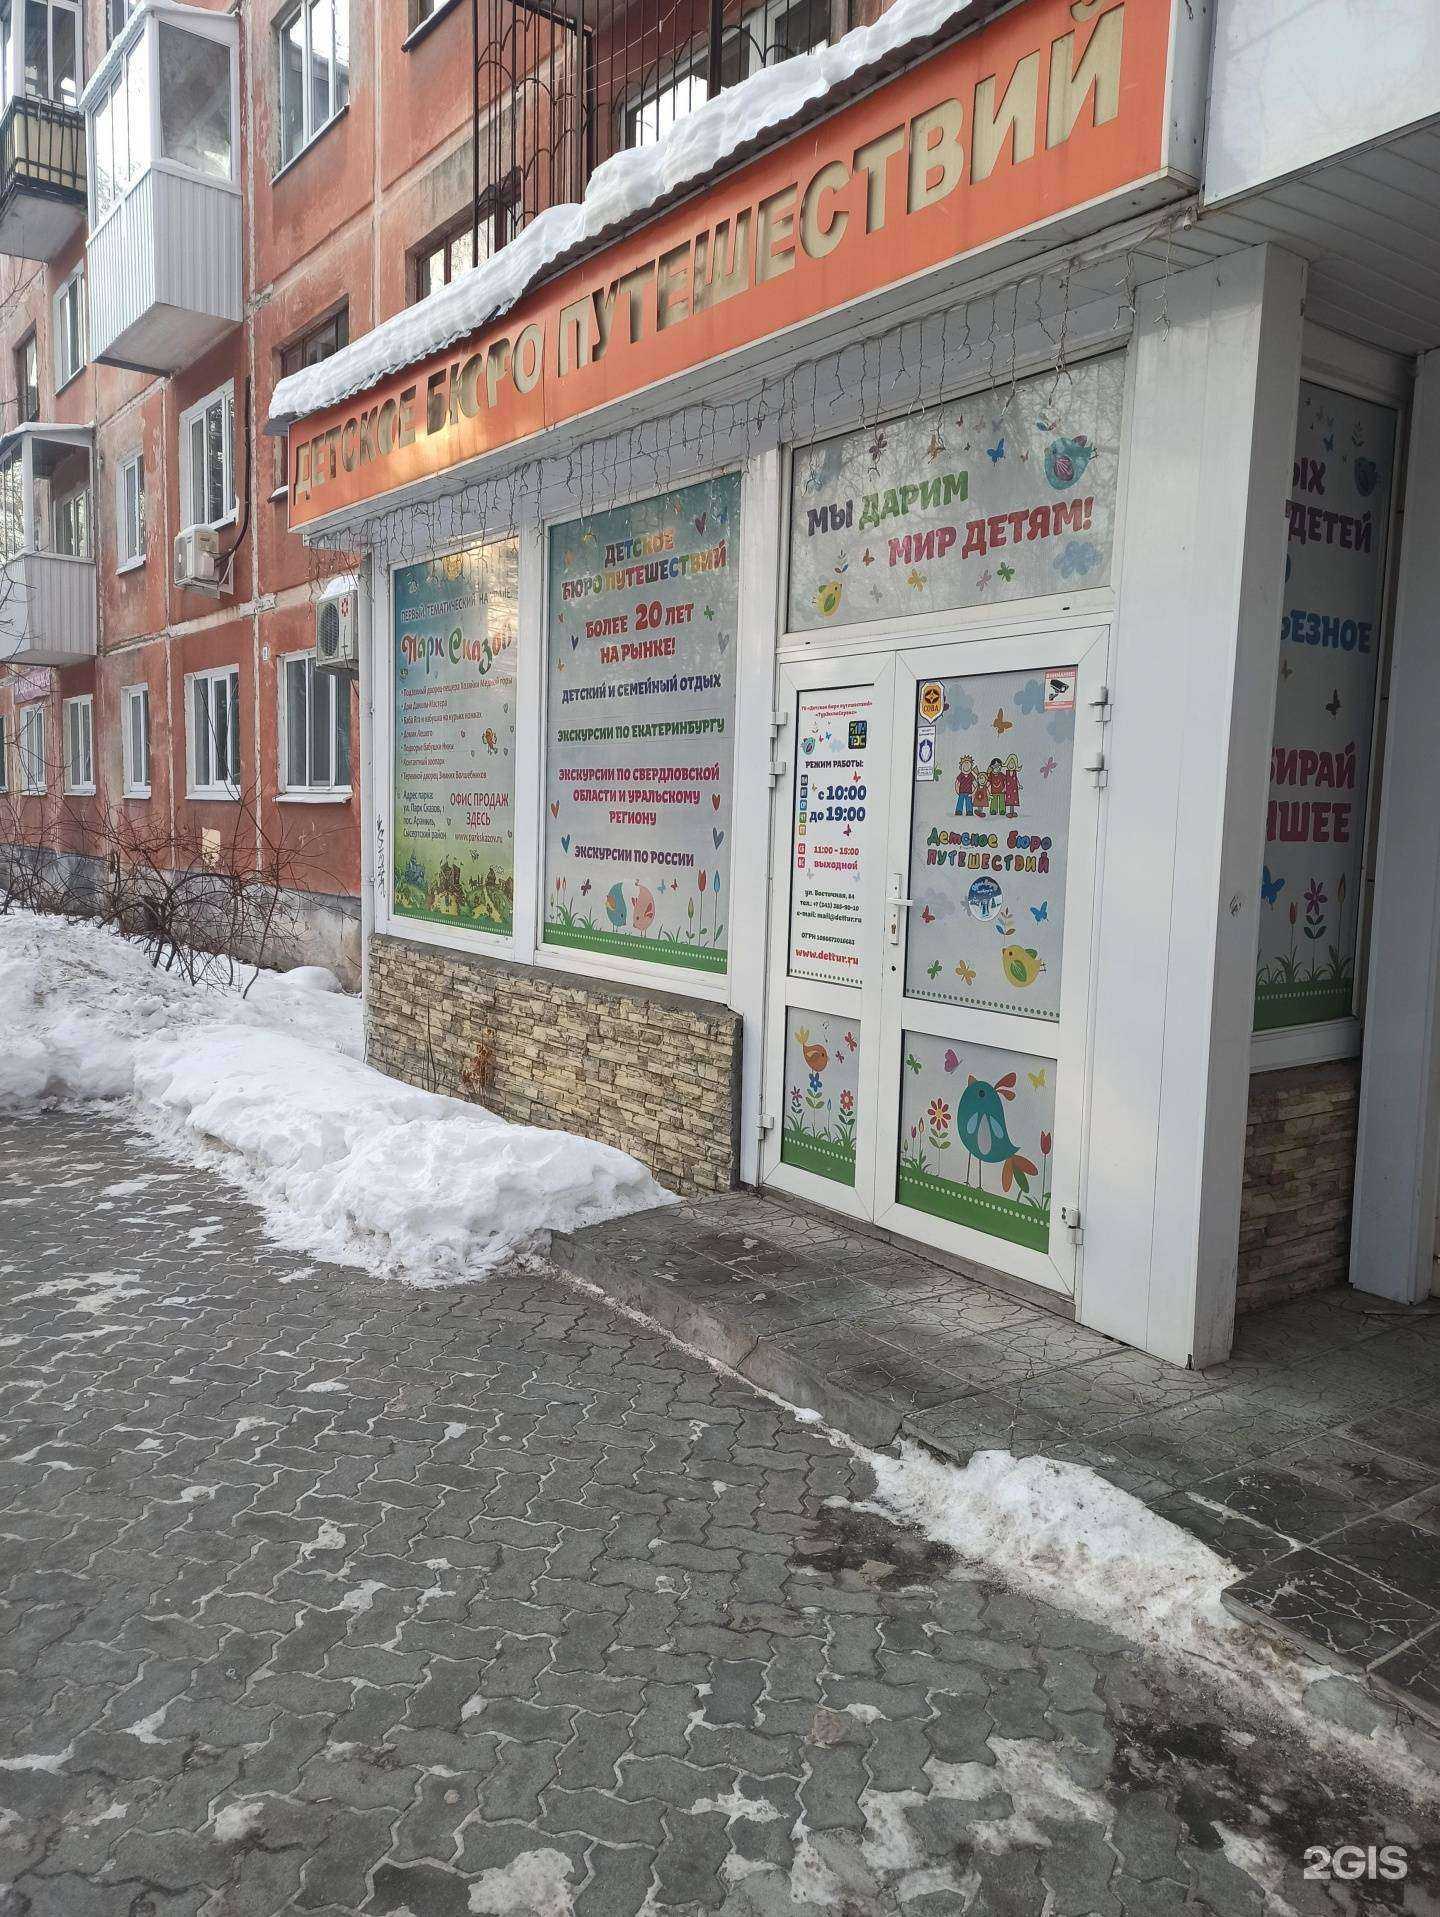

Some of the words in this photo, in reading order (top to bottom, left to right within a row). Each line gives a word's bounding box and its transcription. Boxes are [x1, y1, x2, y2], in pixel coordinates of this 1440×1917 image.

[294, 384, 417, 505] ДЕТСКОЕ
[427, 323, 543, 436] БЮРО
[558, 0, 1125, 378] ПУТЕШЕСТВИЙ
[807, 500, 853, 536] МЫ
[858, 470, 969, 531] ДАРИМ
[888, 526, 956, 567] МИР
[961, 496, 1095, 560] ДЕТЯМ!
[605, 528, 675, 569] ДЕТСКОЕ
[561, 574, 602, 601] БЮРО
[603, 538, 727, 592] ПУТЕШЕСТВИЙ
[426, 592, 477, 616] ТЕМАТИЧЕСКИЙ
[586, 615, 628, 639] БОЛЕЕ
[635, 600, 663, 631] 20
[665, 603, 695, 626] ЛЕТ
[401, 632, 445, 675] Парк
[600, 646, 620, 664] НА
[621, 637, 676, 661] РЫНКЕ!
[562, 682, 606, 705] ДЕТСКИЙ
[608, 685, 616, 698] И
[617, 673, 678, 697] СЕМЕЙНЫЙ
[679, 673, 722, 691] ОТДЫХ
[557, 727, 614, 742] ЭКСКУРСИИ
[615, 725, 629, 739] ПО
[631, 718, 725, 738] ЕКАТЕРИНБУРГУ
[558, 768, 615, 782] ЭКСКУРСИИ
[616, 767, 631, 781] ПО
[632, 762, 720, 783] СВЕРДЛОВСКОЙ
[833, 760, 863, 768] РАБОТЫ:
[450, 793, 472, 806] ОФИС
[473, 793, 509, 811] ПРОДАЖ
[573, 789, 616, 802] ОБЛАСТИ
[618, 790, 626, 801] И
[628, 789, 700, 805] УРАЛЬСКОМУ
[818, 791, 824, 800] с
[826, 785, 867, 800] 10:00
[466, 812, 491, 829] ЗДЕСЬ
[609, 811, 657, 825] РЕГИОНУ
[809, 811, 824, 823] до
[826, 806, 866, 821] 19:00
[814, 846, 833, 854] 11:00
[927, 827, 998, 848] Детское
[1007, 830, 1052, 853] бюро
[574, 845, 632, 862] ЭКСКУРСИИ
[634, 850, 648, 863] ПО
[650, 851, 695, 867] РОССИИ
[814, 860, 858, 871] выходной
[927, 849, 1050, 874] ПУТЕШЕСТВИЙ
